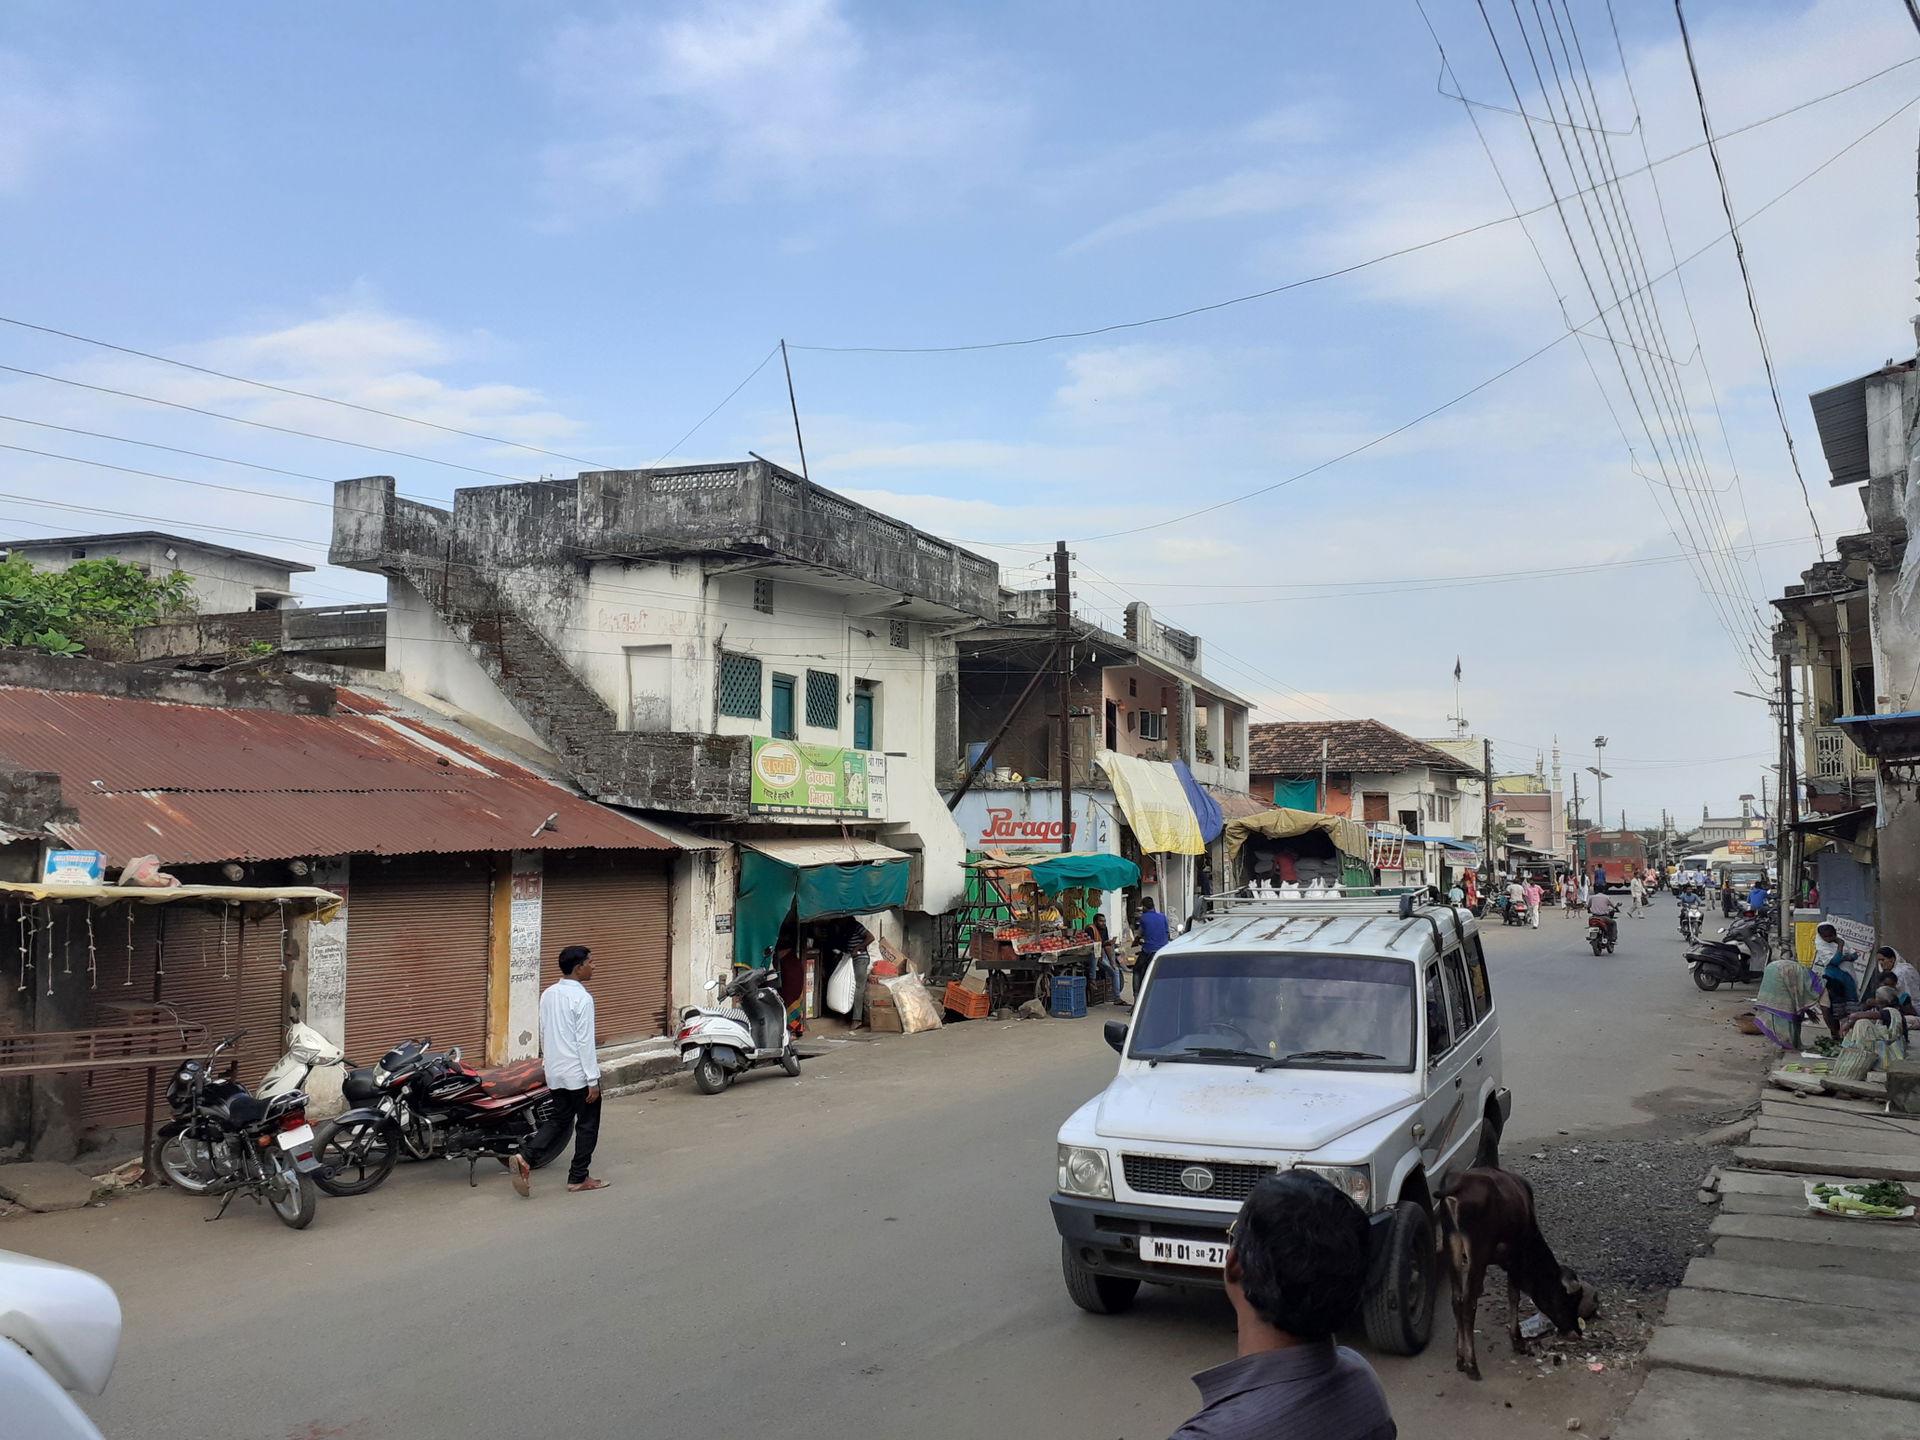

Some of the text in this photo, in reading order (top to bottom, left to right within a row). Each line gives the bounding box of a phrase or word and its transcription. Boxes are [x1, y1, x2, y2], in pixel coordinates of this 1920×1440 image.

[805, 766, 835, 785] ढोकला
[809, 787, 834, 805] मिक्स
[1099, 820, 1107, 829] A
[1098, 832, 1107, 843] 4
[1154, 1242, 1172, 1258] MH
[1177, 1244, 1190, 1260] 01
[1208, 1247, 1230, 1264] 27
